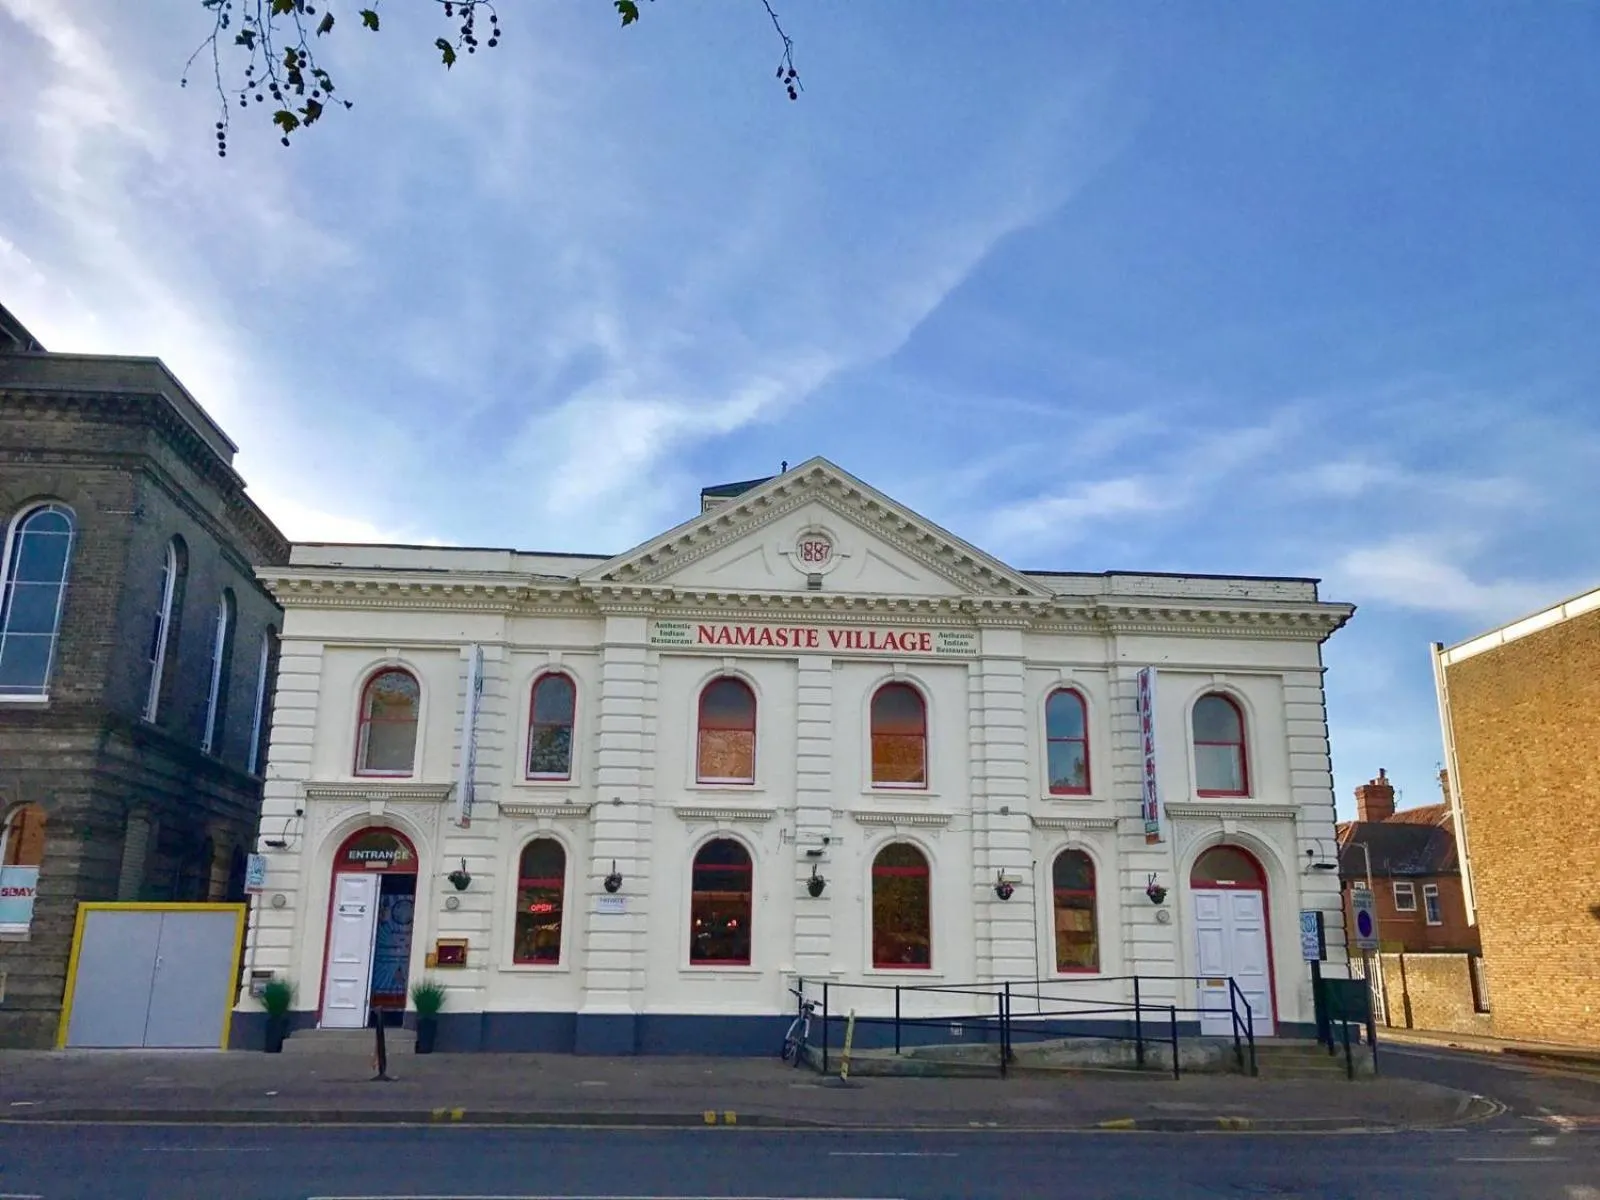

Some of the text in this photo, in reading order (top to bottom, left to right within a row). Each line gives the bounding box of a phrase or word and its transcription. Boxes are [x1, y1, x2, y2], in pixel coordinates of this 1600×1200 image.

[799, 542, 831, 561] 1887
[654, 621, 692, 629] Authentic
[697, 625, 933, 652] NAMASTE VILLAGE
[938, 631, 976, 639] Authentic
[651, 637, 693, 645] Restaurant
[936, 646, 977, 654] Restaurant
[349, 850, 408, 859] ENTRANCE
[530, 903, 552, 912] OPEN
